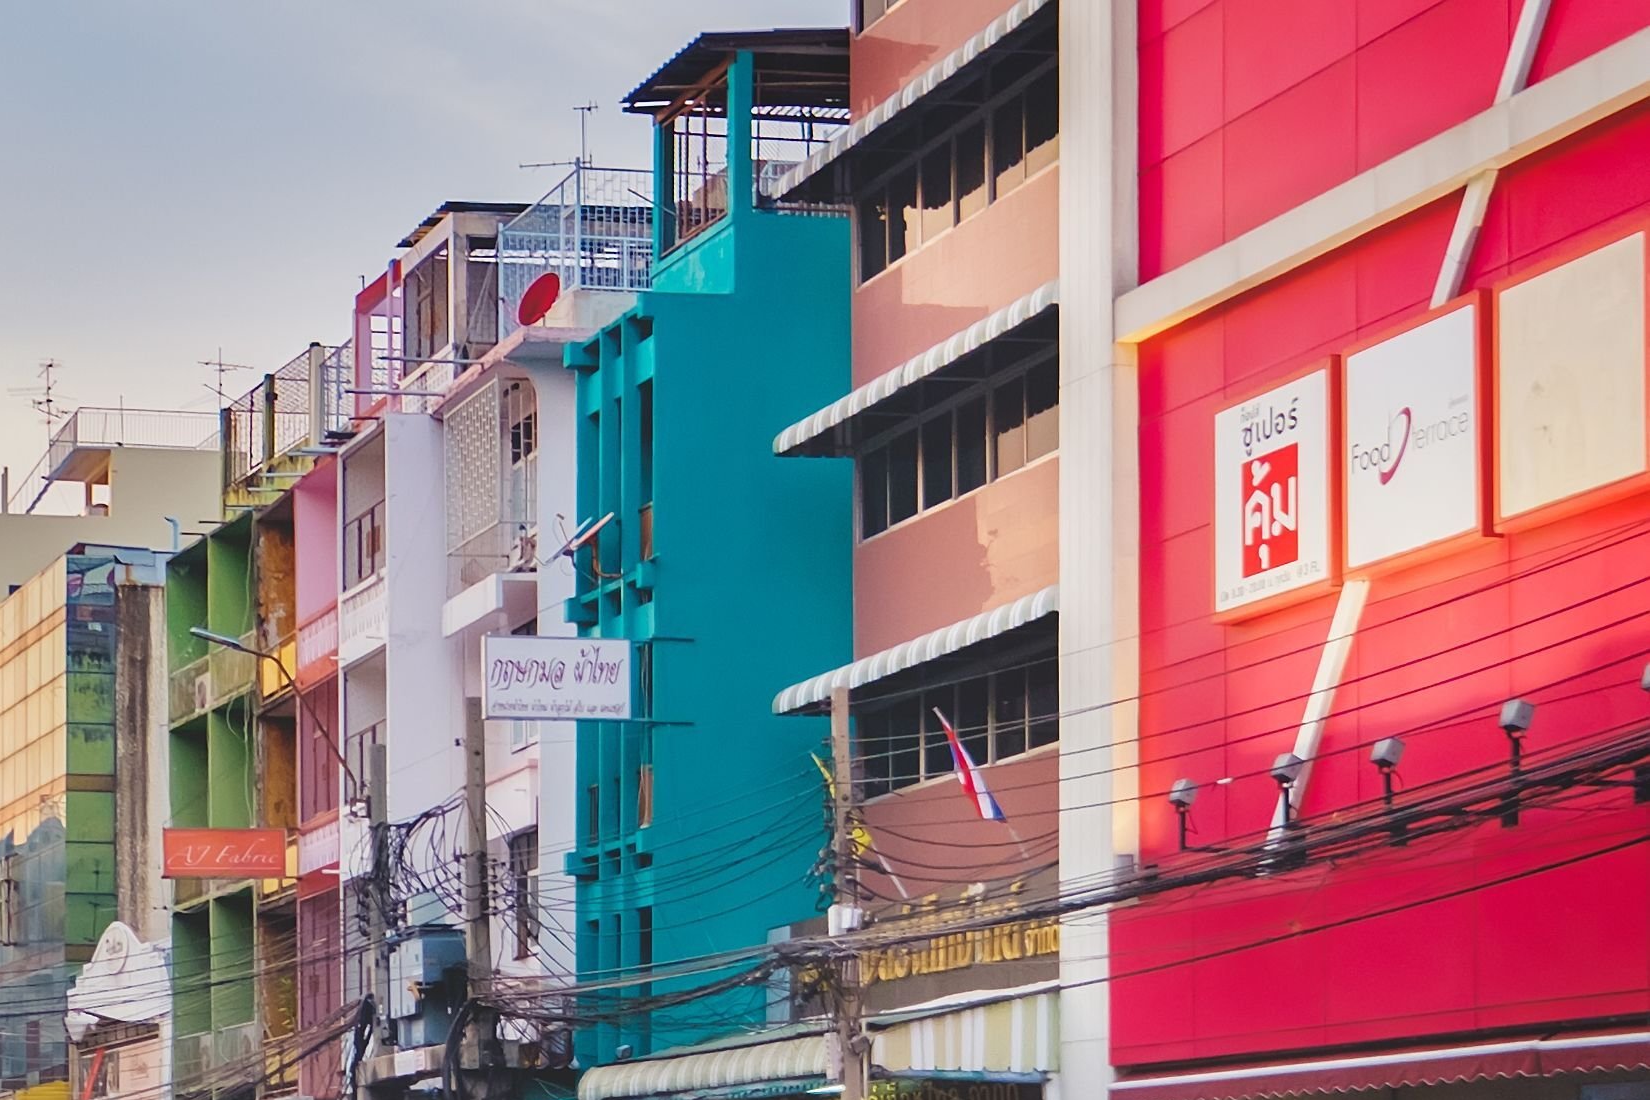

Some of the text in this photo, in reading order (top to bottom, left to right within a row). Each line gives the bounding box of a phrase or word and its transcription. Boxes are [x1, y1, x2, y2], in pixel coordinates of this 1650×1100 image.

[1242, 397, 1299, 456] ซูเปอร์
[1244, 460, 1297, 570] คุ้ม
[215, 838, 280, 864] Fabric
